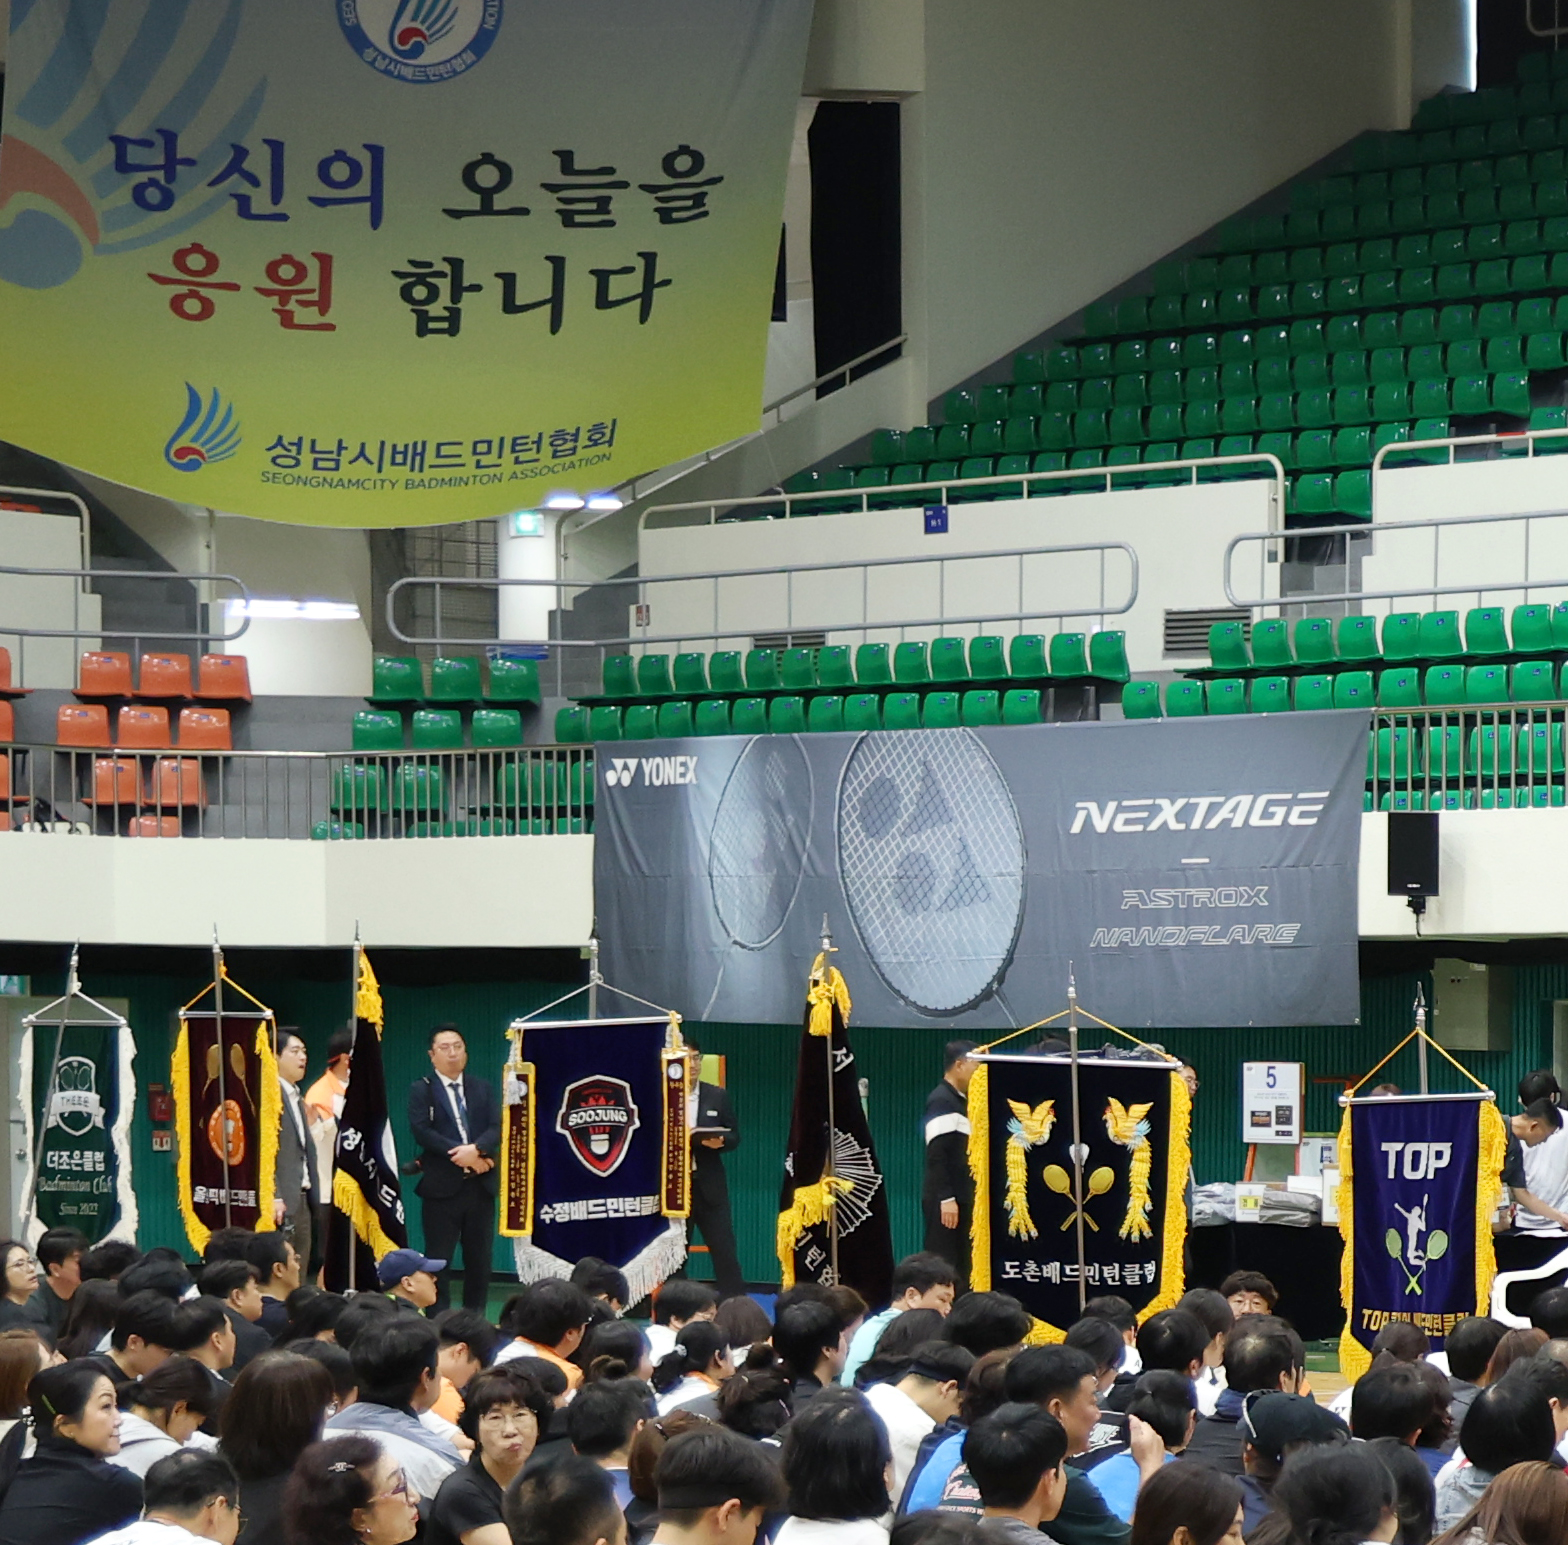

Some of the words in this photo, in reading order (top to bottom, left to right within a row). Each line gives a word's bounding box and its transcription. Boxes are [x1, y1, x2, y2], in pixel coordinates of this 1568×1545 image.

[109, 130, 387, 231] 당신의
[441, 144, 725, 229] 오늘을
[147, 242, 338, 332] 응원
[391, 251, 673, 338] 합니다
[265, 418, 618, 474] 성남시배드민턴협회
[261, 471, 399, 490] SEONGNAMCITY
[404, 472, 503, 490] BADMINTON
[507, 452, 612, 482] ASSOCIATION
[641, 755, 698, 786] YONEX
[1070, 791, 1330, 834] NEXTAGE
[1121, 885, 1269, 910] ASTROX
[1089, 923, 1301, 948] NANOFLARE
[1266, 1066, 1277, 1089] 5
[568, 1109, 628, 1127] SOOJUNG
[46, 1150, 105, 1172] 더조은클럽
[1381, 1141, 1452, 1180] TOP
[1001, 1259, 1155, 1287] 도촌배드민턴클럽
